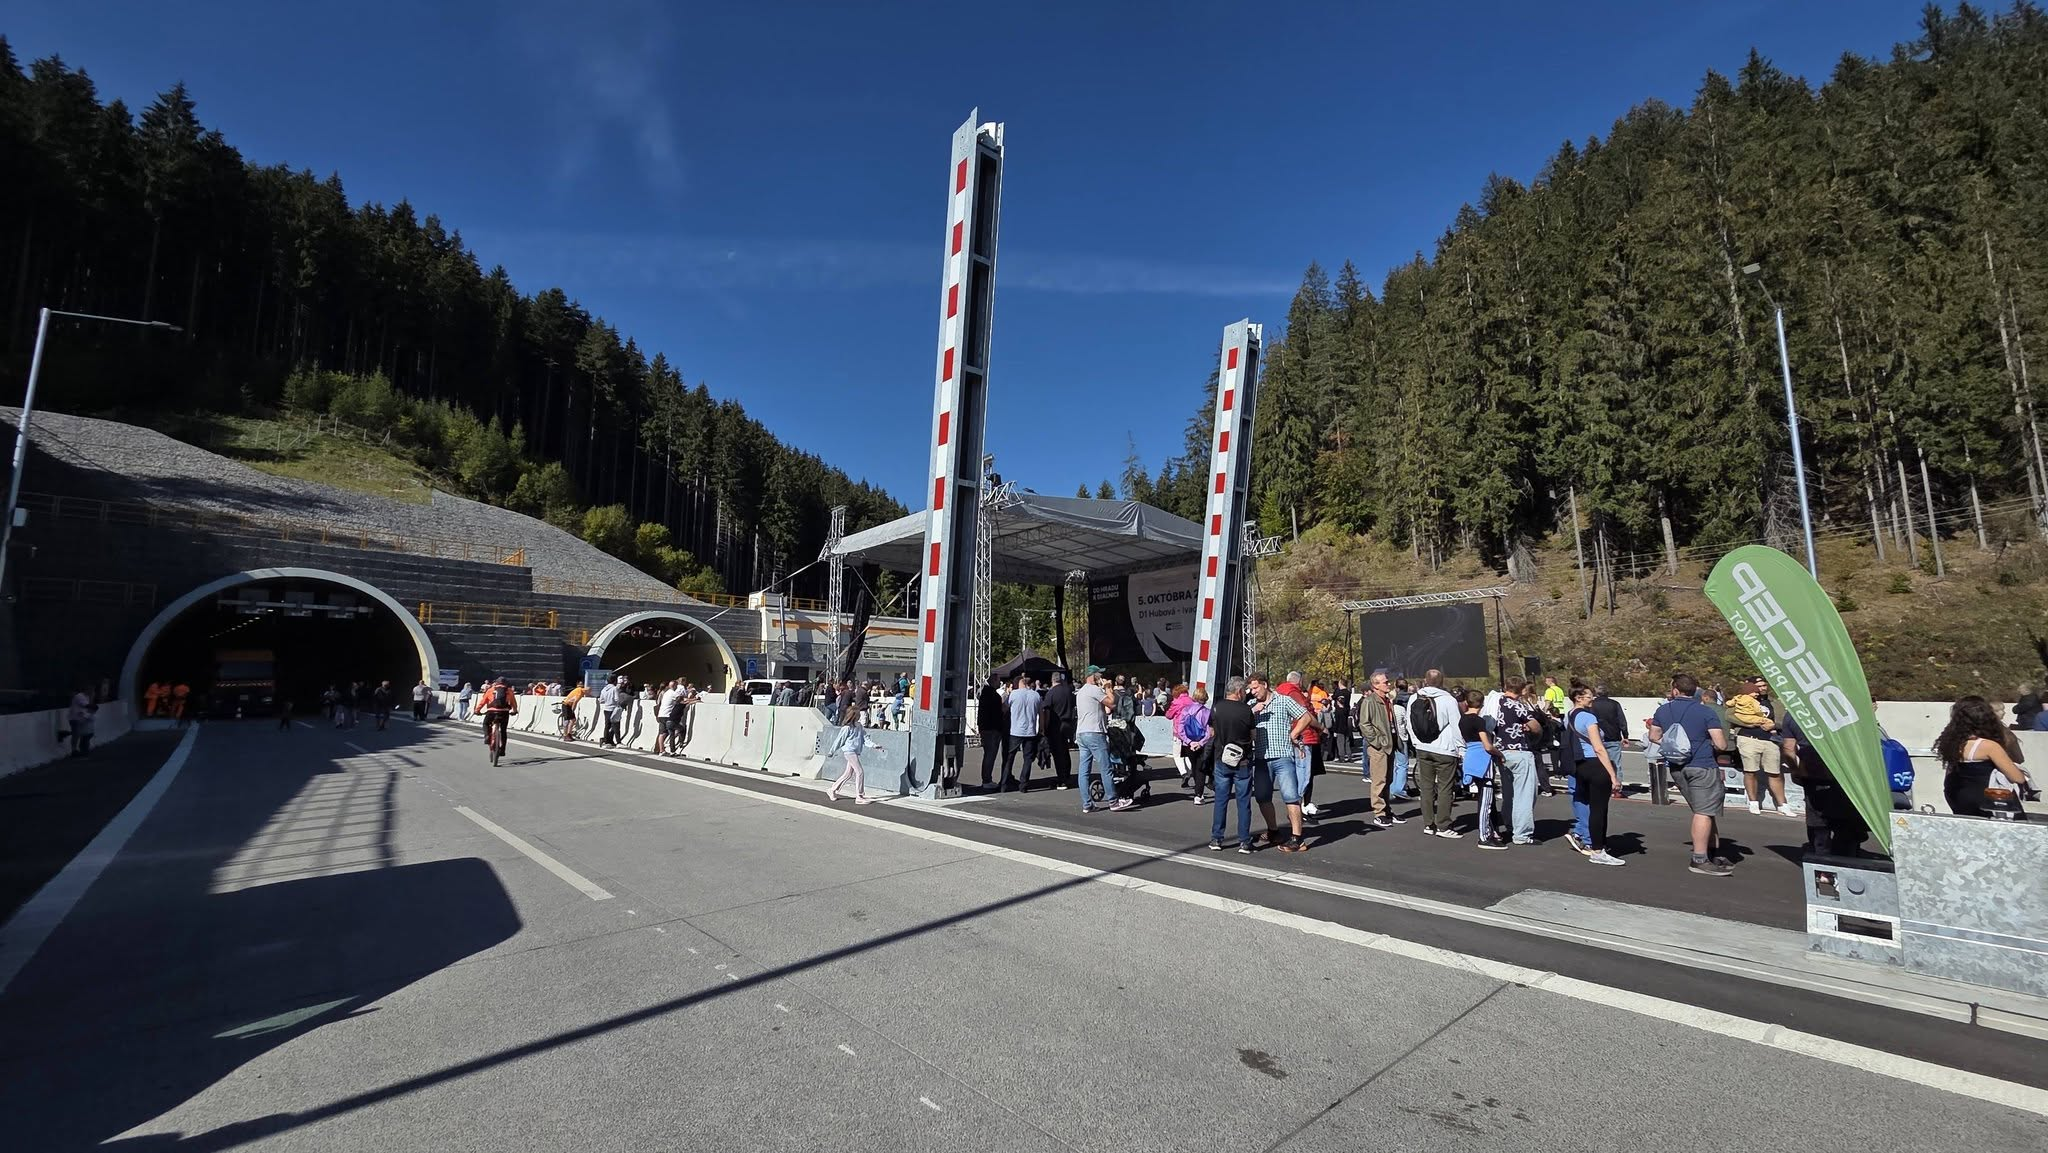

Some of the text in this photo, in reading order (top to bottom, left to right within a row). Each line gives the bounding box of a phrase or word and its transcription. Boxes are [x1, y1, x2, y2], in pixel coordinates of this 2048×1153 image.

[1138, 596, 1146, 605] 5.
[1147, 590, 1192, 604] OKTÓBRA
[1139, 610, 1147, 619] D1
[1149, 607, 1176, 618] Hubová
